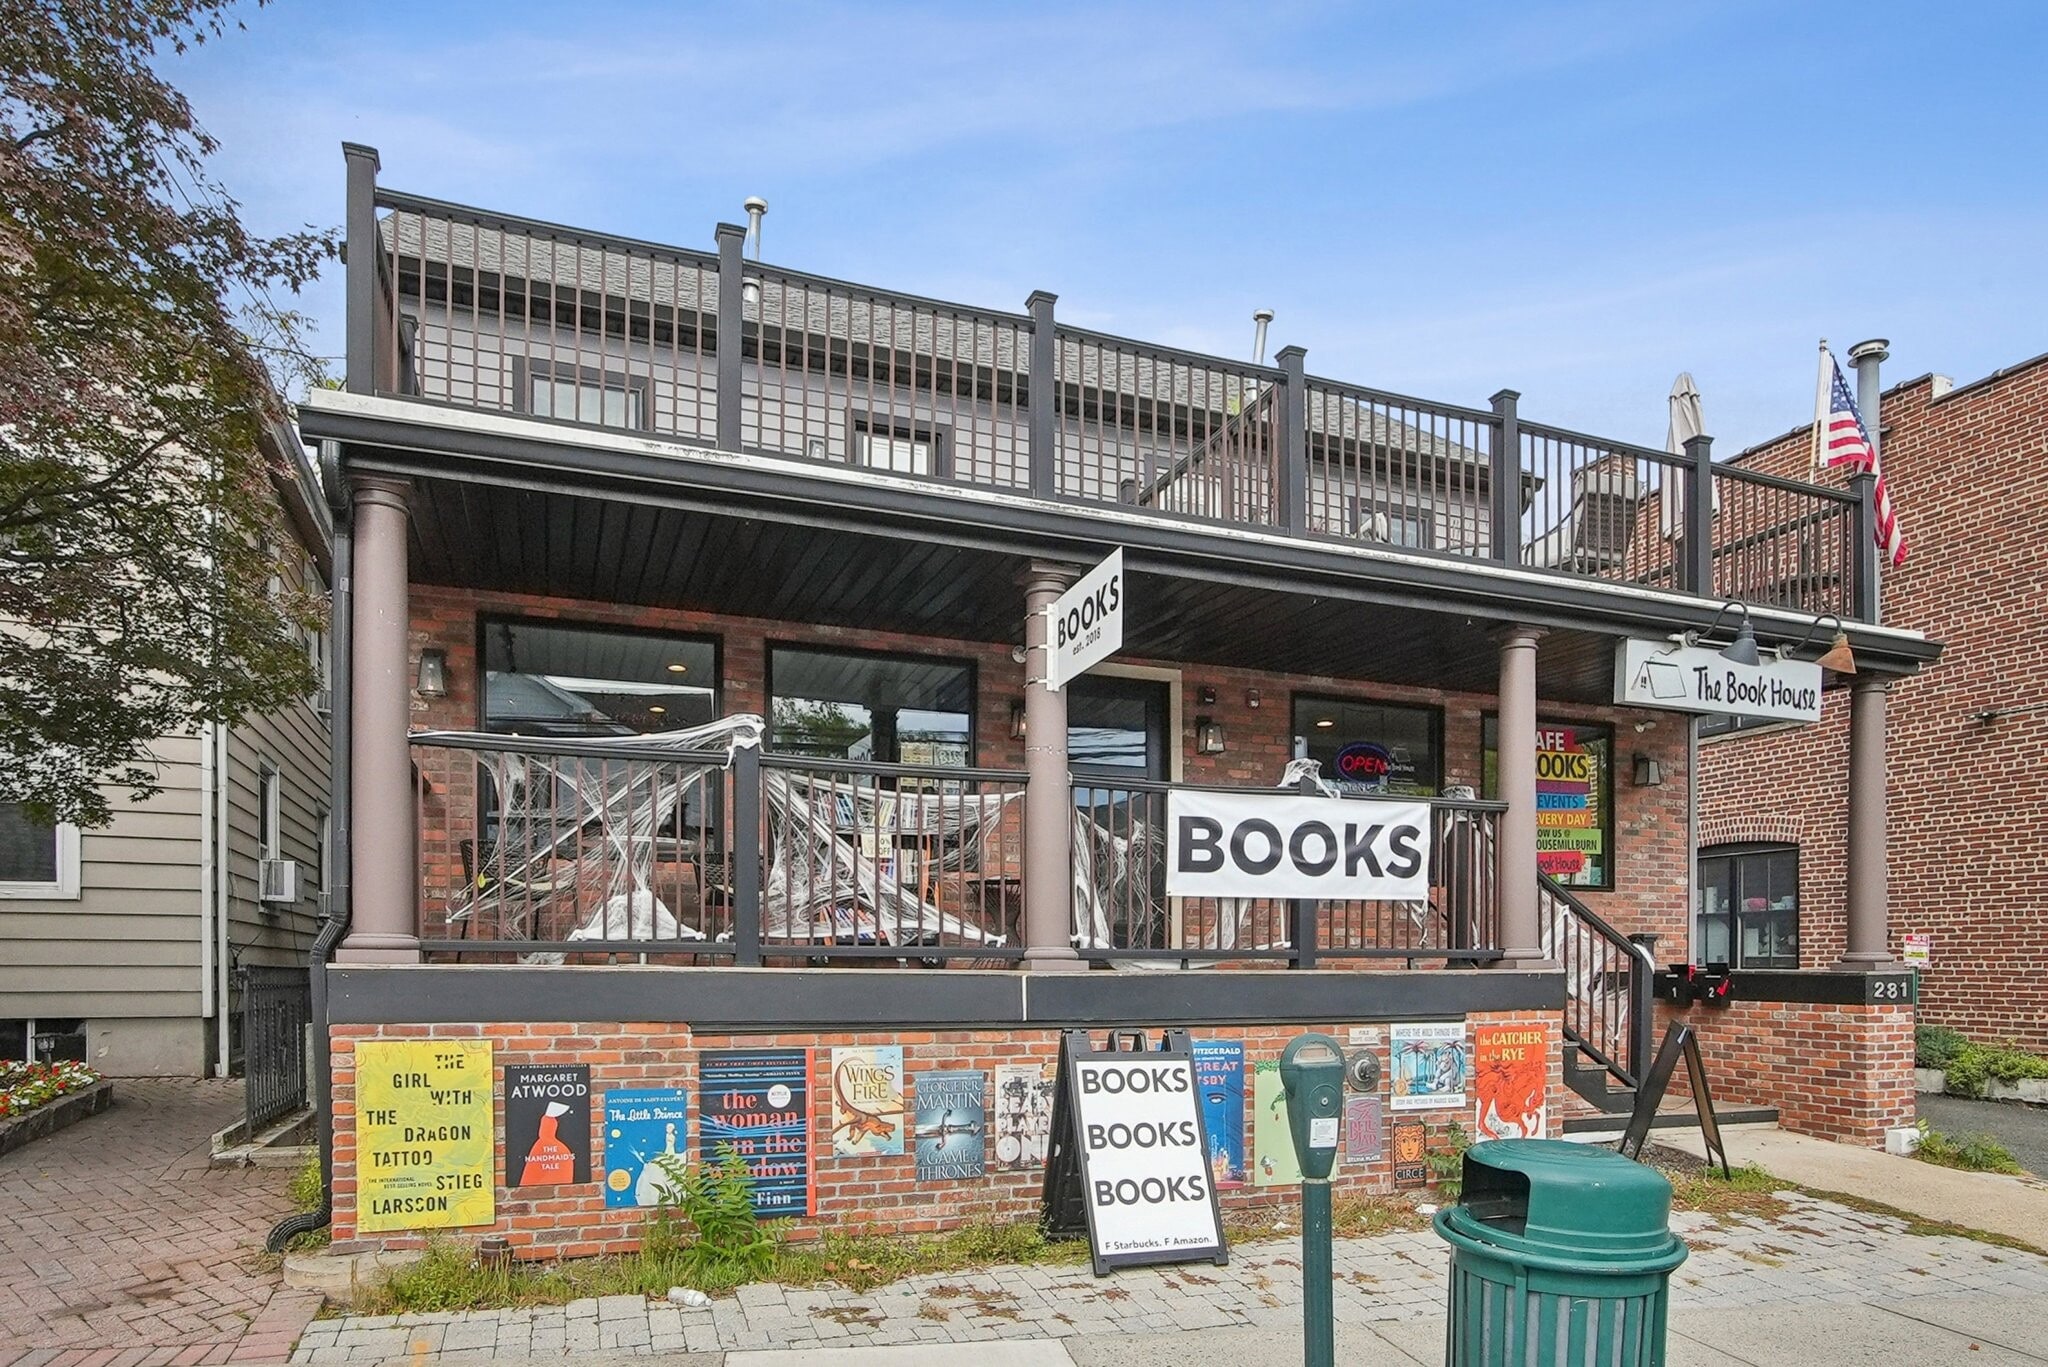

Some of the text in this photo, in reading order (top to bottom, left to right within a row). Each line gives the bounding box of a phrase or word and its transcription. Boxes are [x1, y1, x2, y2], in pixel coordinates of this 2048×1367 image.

[1058, 575, 1119, 649] BOOKS
[1072, 641, 1085, 655] est.
[1692, 666, 1816, 711] The Book House
[1536, 731, 1565, 751] AFE
[1341, 754, 1387, 774] OPEN
[1536, 754, 1588, 778] OOKS
[1537, 795, 1579, 809] EVENTS
[1566, 814, 1588, 825] DAY
[1552, 829, 1563, 837] US
[1178, 815, 1422, 879] BOOKS
[1536, 839, 1597, 850] OUSEMILLBURN
[1538, 856, 1580, 871] ook House
[1671, 986, 1677, 998] 1
[1708, 986, 1715, 998] 2
[1873, 981, 1908, 999] 281
[1480, 1031, 1542, 1046] the CATCHER
[435, 1054, 465, 1069] THE
[1501, 1047, 1526, 1061] RYE
[843, 1064, 895, 1084] WINGS
[1195, 1061, 1238, 1072] GREAT
[393, 1072, 431, 1088] GIRL
[520, 1073, 578, 1083] MARGARET
[1082, 1067, 1188, 1094] BOOKS
[511, 1083, 587, 1098] ATWOOD
[853, 1082, 888, 1100] FIRE
[917, 1081, 960, 1093] GEORGE
[431, 1089, 472, 1106] WITH
[722, 1089, 758, 1110] the
[917, 1092, 981, 1110] MARTIN
[366, 1110, 397, 1125] THE
[608, 1107, 684, 1121] The Little Prince
[711, 1111, 798, 1129] woman
[999, 1114, 1050, 1134] PLAYE
[404, 1125, 471, 1142] DRAGON
[1087, 1121, 1197, 1149] BOOKS
[732, 1131, 802, 1154] in the
[372, 1150, 433, 1167] TATTOO
[524, 1153, 576, 1162] HANDMAID'S
[926, 1149, 969, 1165] GAME
[919, 1163, 982, 1180] THRONES
[1395, 1168, 1425, 1180] CIRCE
[436, 1174, 483, 1190] STIEG
[757, 1191, 791, 1206] Finn
[1095, 1175, 1206, 1206] BOOKS
[372, 1196, 448, 1215] LARSSON
[1105, 1236, 1213, 1250] F Starbucks. F Amazon.
